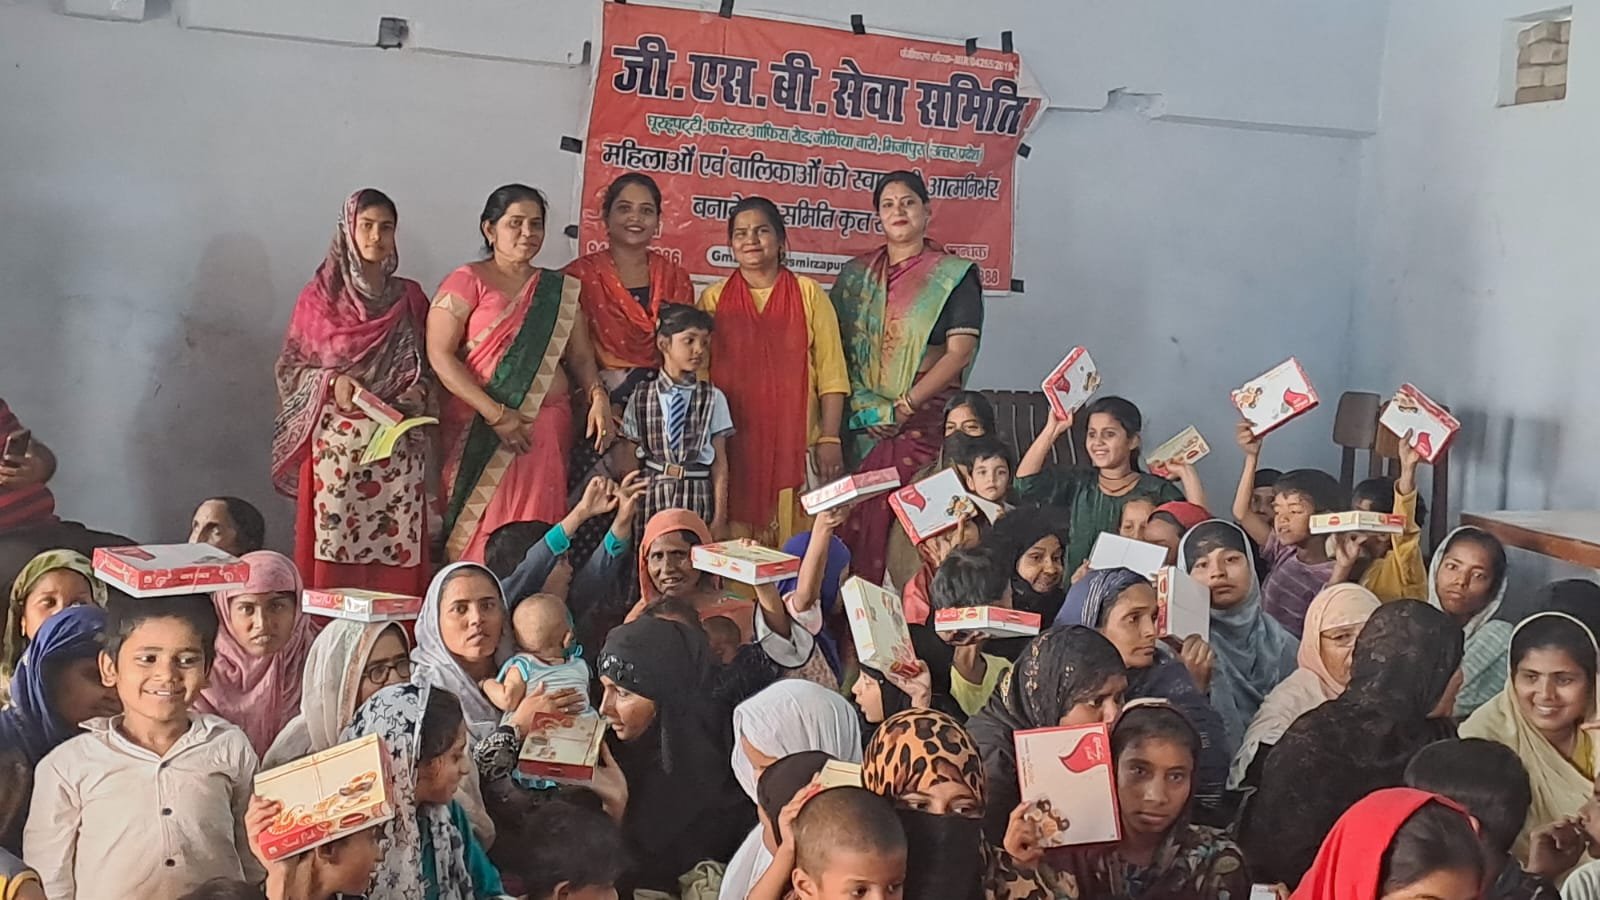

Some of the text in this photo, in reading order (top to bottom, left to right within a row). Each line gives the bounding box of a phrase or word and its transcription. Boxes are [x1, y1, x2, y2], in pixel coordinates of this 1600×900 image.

[831, 58, 909, 123] सेवा
[915, 71, 1030, 136] समिति
[602, 137, 697, 174] महिलाओं
[698, 147, 729, 178] एवं
[728, 150, 823, 187] बालिकाओं
[823, 160, 851, 190] को
[837, 208, 875, 239] कृत
